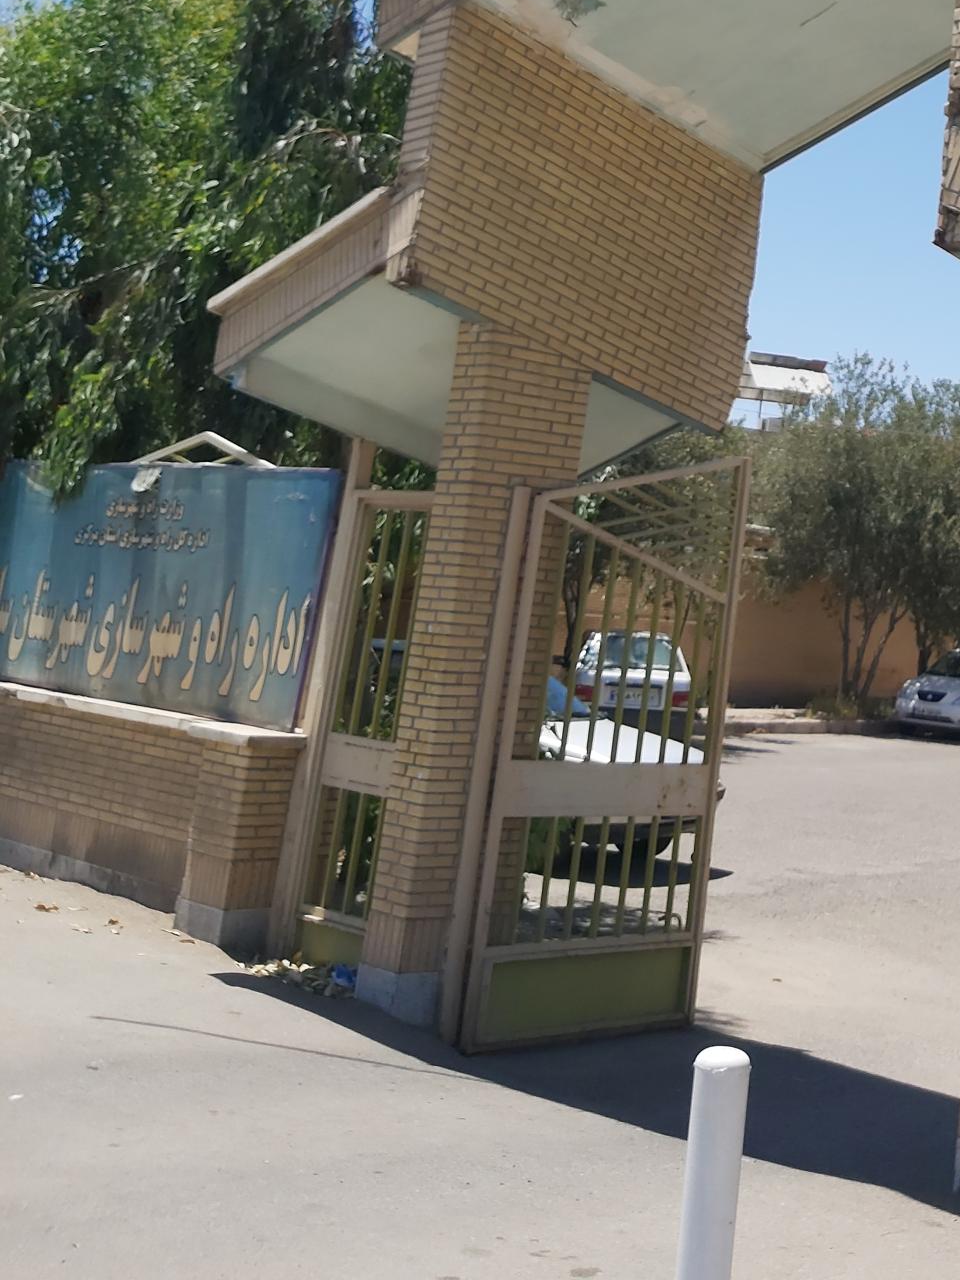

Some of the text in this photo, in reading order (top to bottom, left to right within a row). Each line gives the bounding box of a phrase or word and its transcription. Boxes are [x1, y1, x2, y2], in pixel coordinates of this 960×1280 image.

[180, 615, 202, 690] و
[203, 581, 240, 696] راه
[242, 585, 312, 702] اداره
